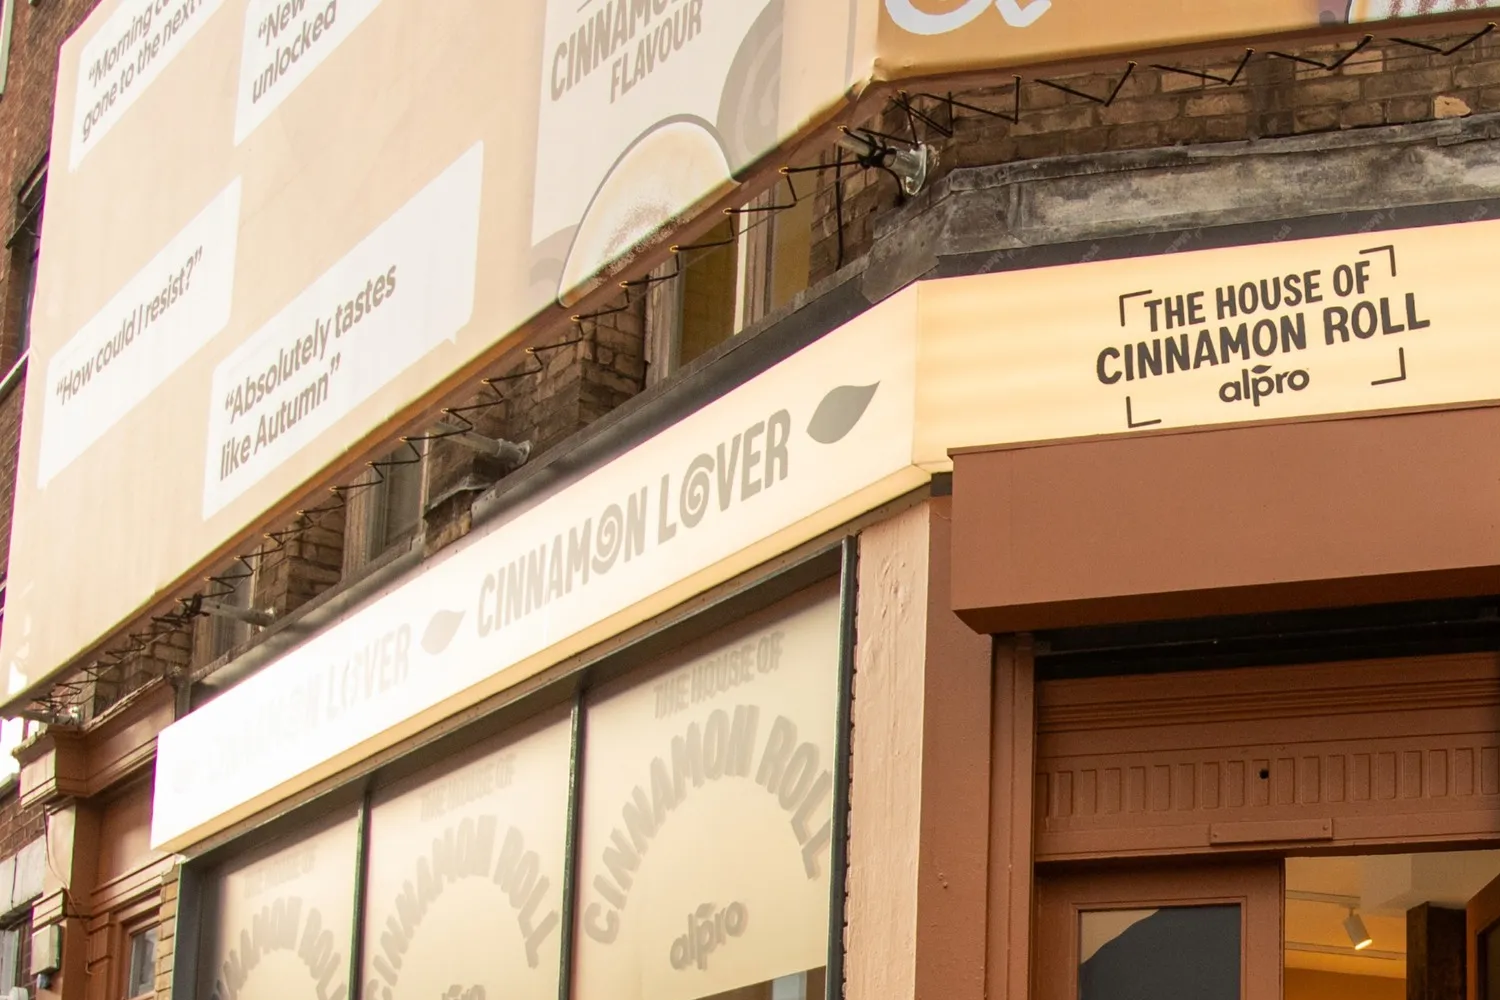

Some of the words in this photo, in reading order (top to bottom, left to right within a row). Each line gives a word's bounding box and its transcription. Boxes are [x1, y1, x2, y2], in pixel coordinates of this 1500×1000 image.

[82, 82, 117, 143] gone
[120, 62, 135, 94] to
[137, 33, 161, 76] the
[551, 0, 680, 101] CINNAM
[610, 0, 704, 104] FLAVOUR
[96, 312, 135, 374] could
[137, 304, 144, 336] I
[335, 264, 396, 339] tastes
[1096, 312, 1306, 385] CINNAMON
[1323, 292, 1431, 345] ROLL
[1144, 291, 1206, 332] THE
[1216, 269, 1323, 320] HOUSE
[1333, 260, 1370, 297] OF
[1218, 365, 1310, 407] alpro
[220, 431, 251, 482] like
[476, 486, 648, 638] CINNAMON
[658, 409, 791, 545] LOVER
[653, 673, 689, 719] THE
[690, 644, 755, 704] HOUSE
[757, 630, 785, 674] OF
[584, 704, 760, 945] CINNAMON
[755, 715, 832, 880] ROLL
